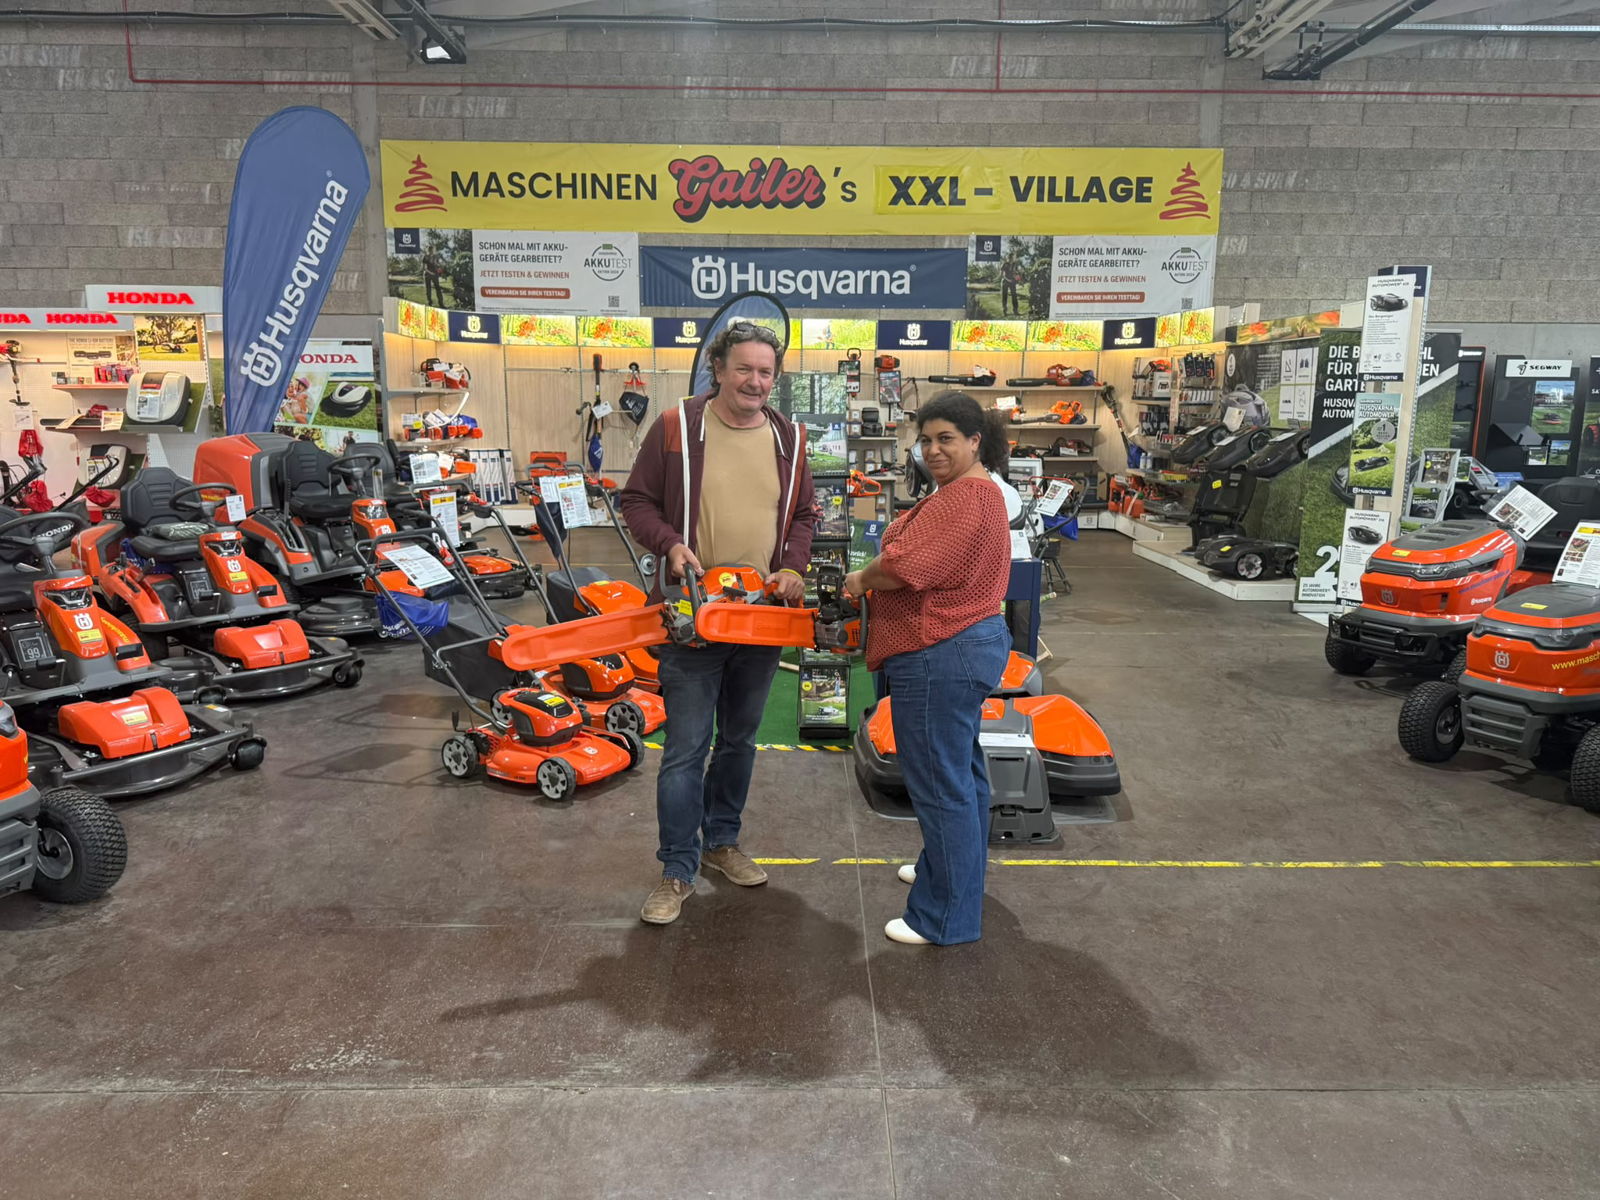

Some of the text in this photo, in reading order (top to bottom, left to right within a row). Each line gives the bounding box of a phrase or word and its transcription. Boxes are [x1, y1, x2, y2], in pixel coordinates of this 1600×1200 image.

[451, 171, 657, 201] MASCHINEN
[668, 155, 826, 223] Gailer
[888, 175, 966, 206] XXL
[1009, 175, 1153, 203] VILLAGE
[479, 242, 568, 252] SCHON MAL MIT AKKU-
[1059, 248, 1147, 256] SCHON MAL MIT AKKU-
[259, 178, 348, 351] Husqvarna
[479, 253, 562, 264] GERÄTE GEARBEITET?
[584, 257, 632, 269] AKKUTEST
[1058, 258, 1140, 268] GERÄTE GEARBEITET?
[1161, 261, 1208, 271] AKKUTEST
[480, 270, 499, 278] JETZT
[501, 271, 526, 279] TESTEN
[534, 271, 570, 279] GEWINNEN
[730, 262, 911, 300] Husqvarna
[107, 292, 195, 305] HONDA
[46, 313, 118, 324] HONDA
[1328, 346, 1349, 358] DIE
[300, 353, 358, 365] ONDA
[1327, 360, 1352, 375] FÜR
